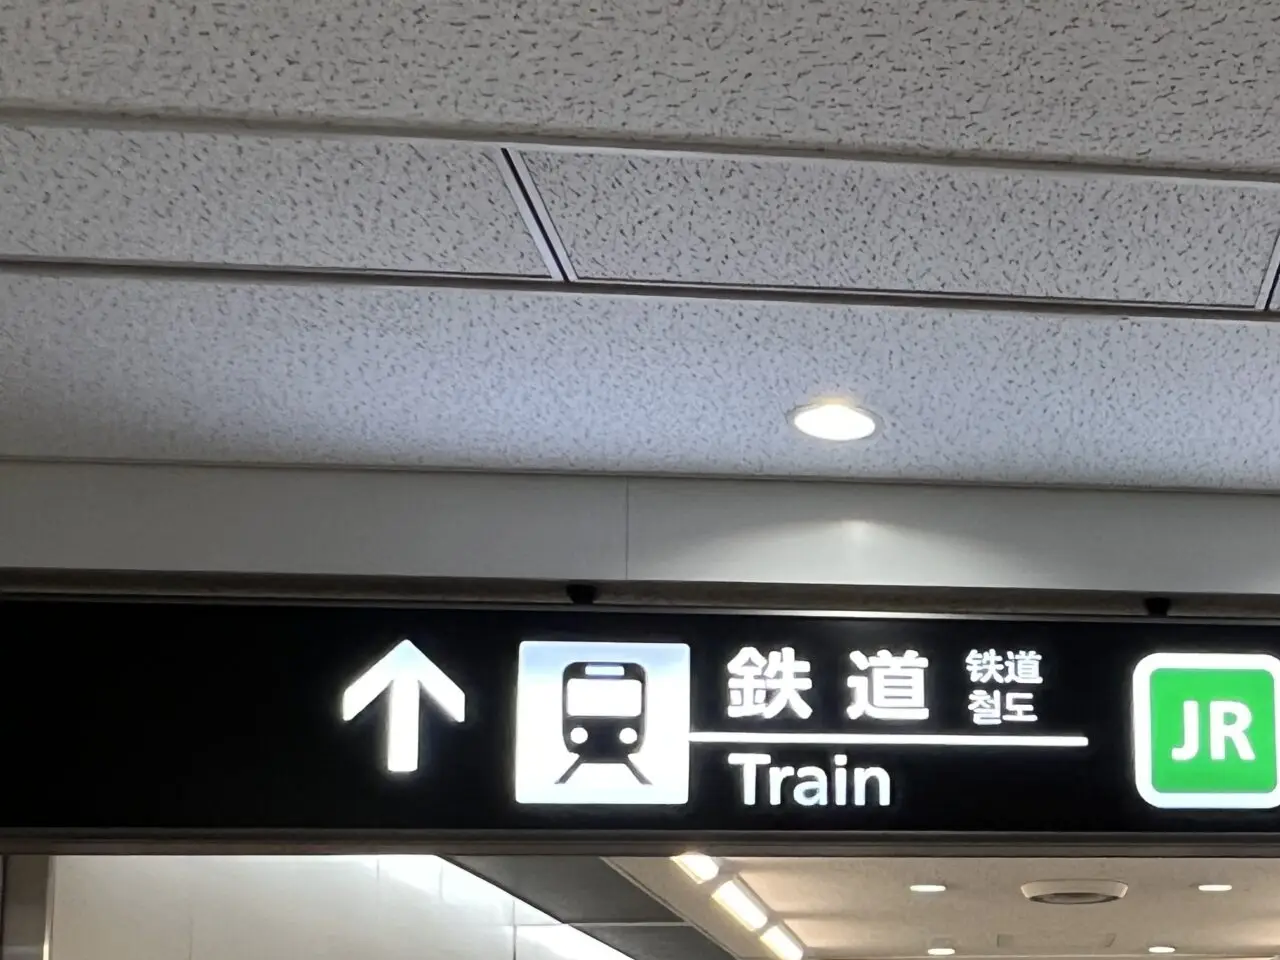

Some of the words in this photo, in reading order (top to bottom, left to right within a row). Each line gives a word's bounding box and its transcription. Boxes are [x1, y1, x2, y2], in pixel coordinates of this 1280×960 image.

[965, 649, 1043, 684] 铁道
[968, 690, 1038, 725] 철도
[1171, 700, 1256, 761] JR
[728, 753, 890, 806] Train
